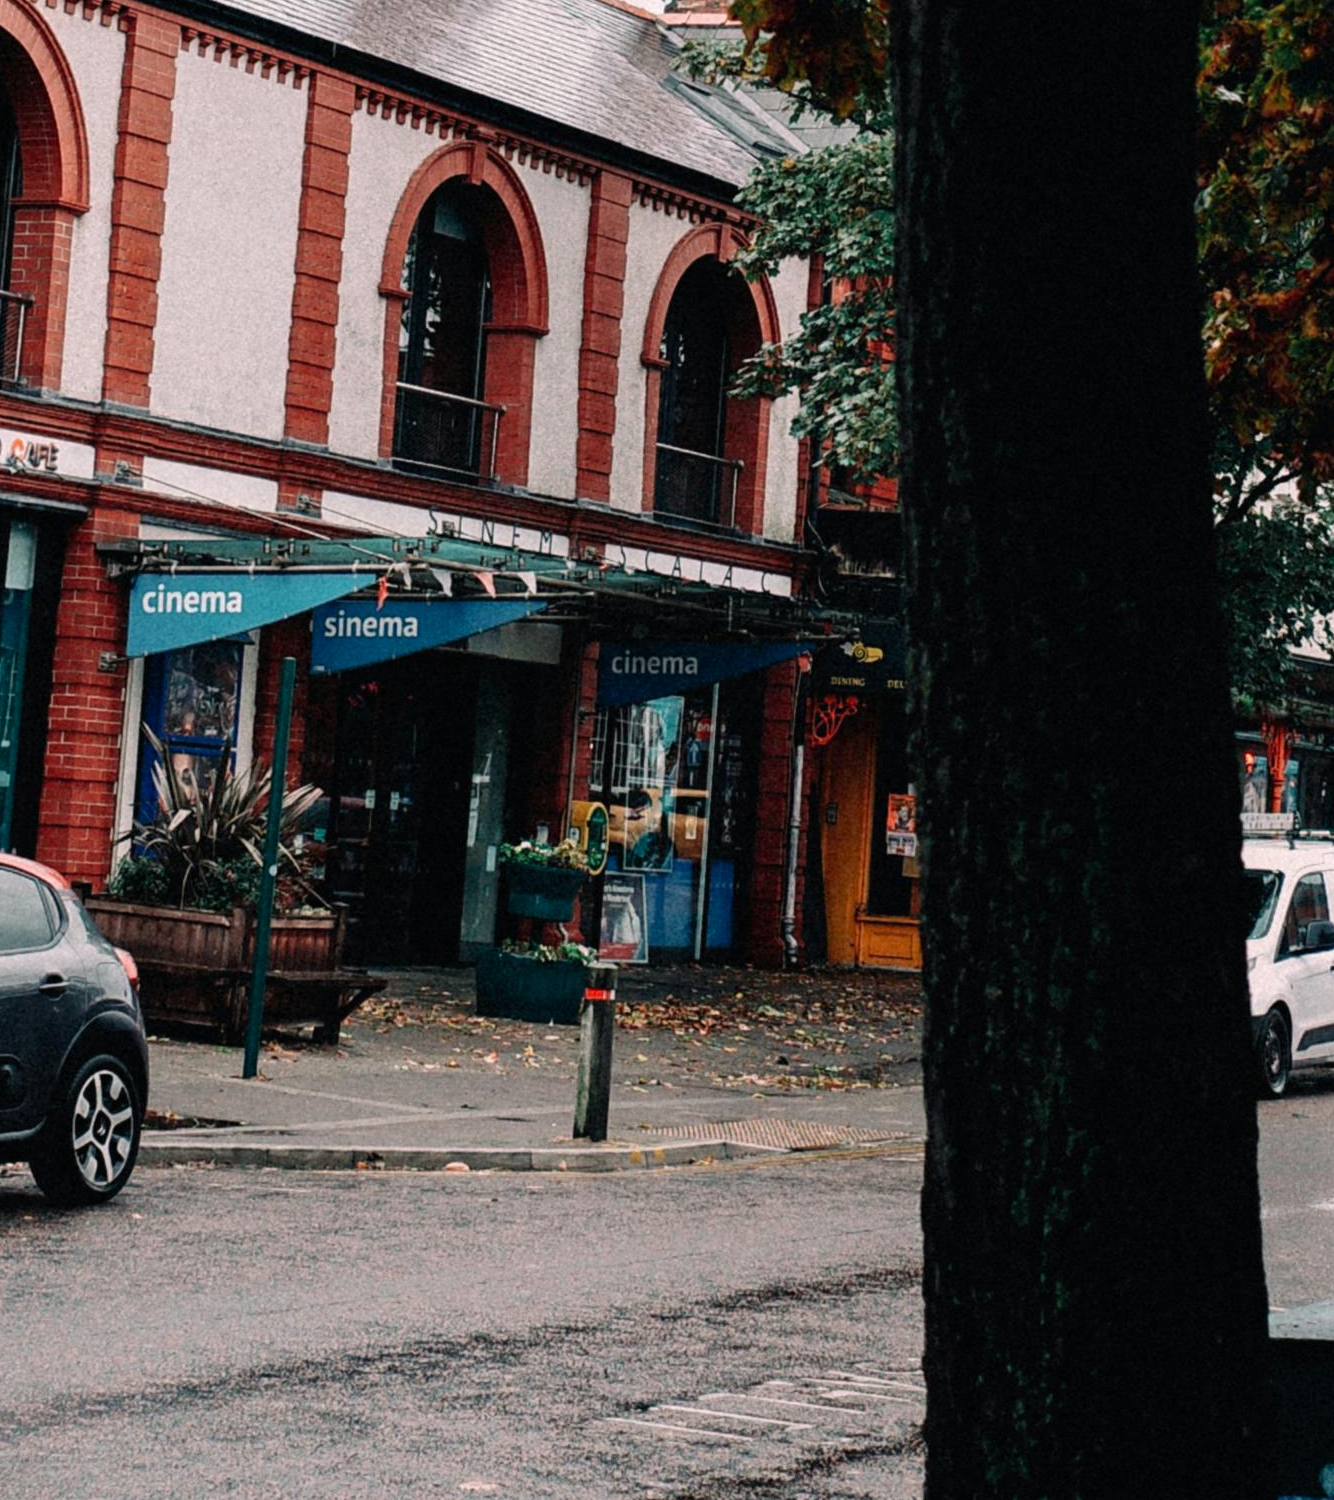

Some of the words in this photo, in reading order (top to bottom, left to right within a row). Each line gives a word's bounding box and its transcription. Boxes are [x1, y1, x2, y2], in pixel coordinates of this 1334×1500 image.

[142, 584, 243, 614] cinema
[324, 610, 418, 637] sinema
[611, 651, 699, 676] cinema
[831, 676, 866, 687] DINING
